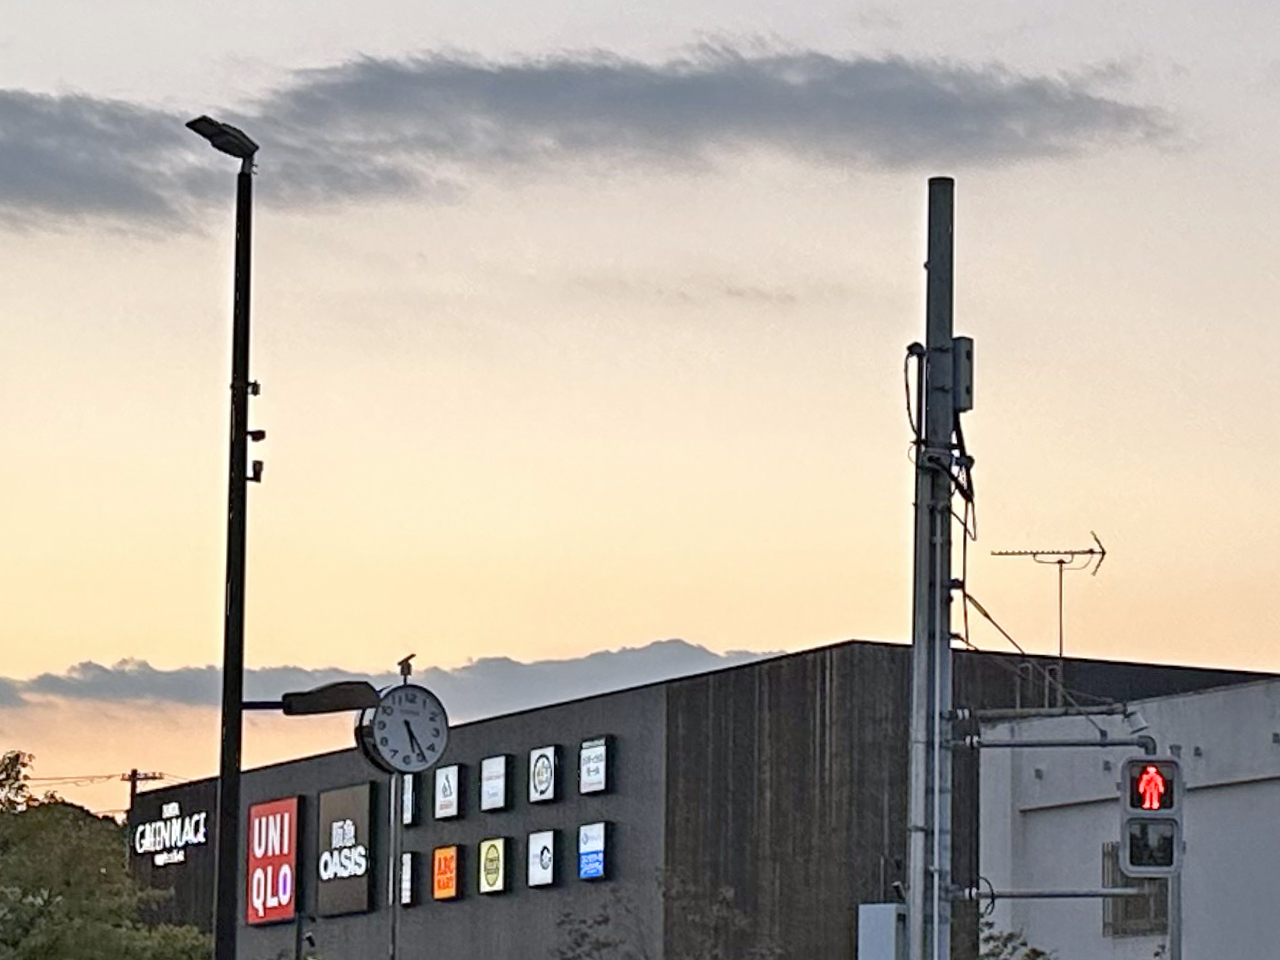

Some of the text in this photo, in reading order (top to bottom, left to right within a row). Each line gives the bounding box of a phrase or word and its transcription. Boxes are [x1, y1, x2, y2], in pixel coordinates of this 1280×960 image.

[253, 812, 290, 859] UNI
[318, 845, 368, 880] OASIS
[252, 863, 292, 918] QLO
